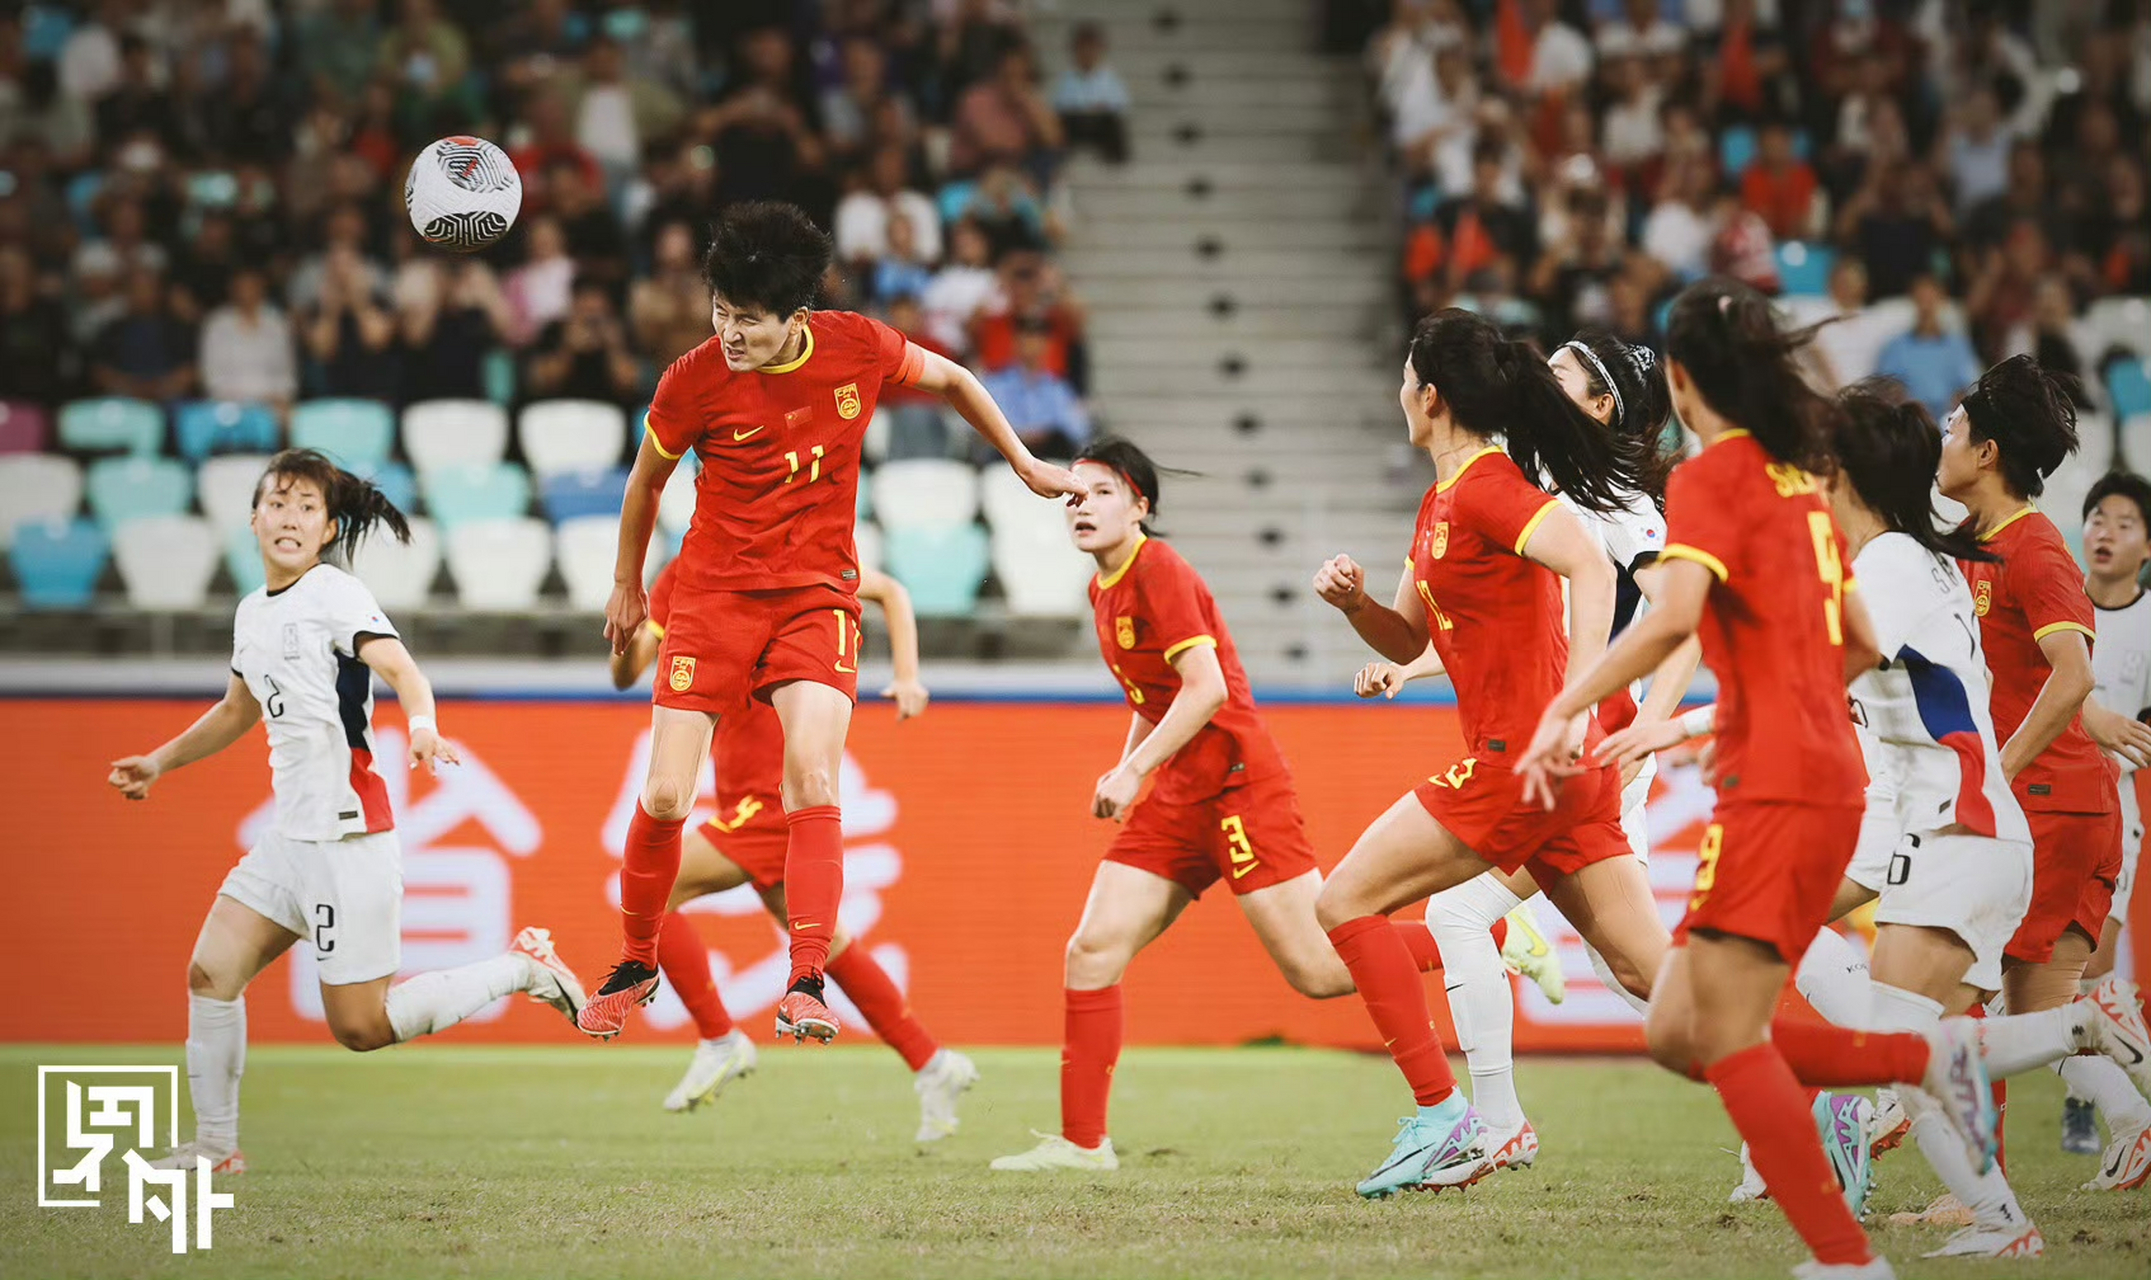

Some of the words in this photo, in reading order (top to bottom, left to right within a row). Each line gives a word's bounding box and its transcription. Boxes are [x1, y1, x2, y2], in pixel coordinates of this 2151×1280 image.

[784, 445, 824, 483] 11
[1807, 511, 1843, 646] 9
[1416, 580, 1453, 630] 12
[264, 673, 285, 718] 2
[1221, 815, 1254, 864] 3
[1696, 824, 1724, 892] 9
[1886, 832, 1921, 885] 6
[315, 903, 335, 952] 2
